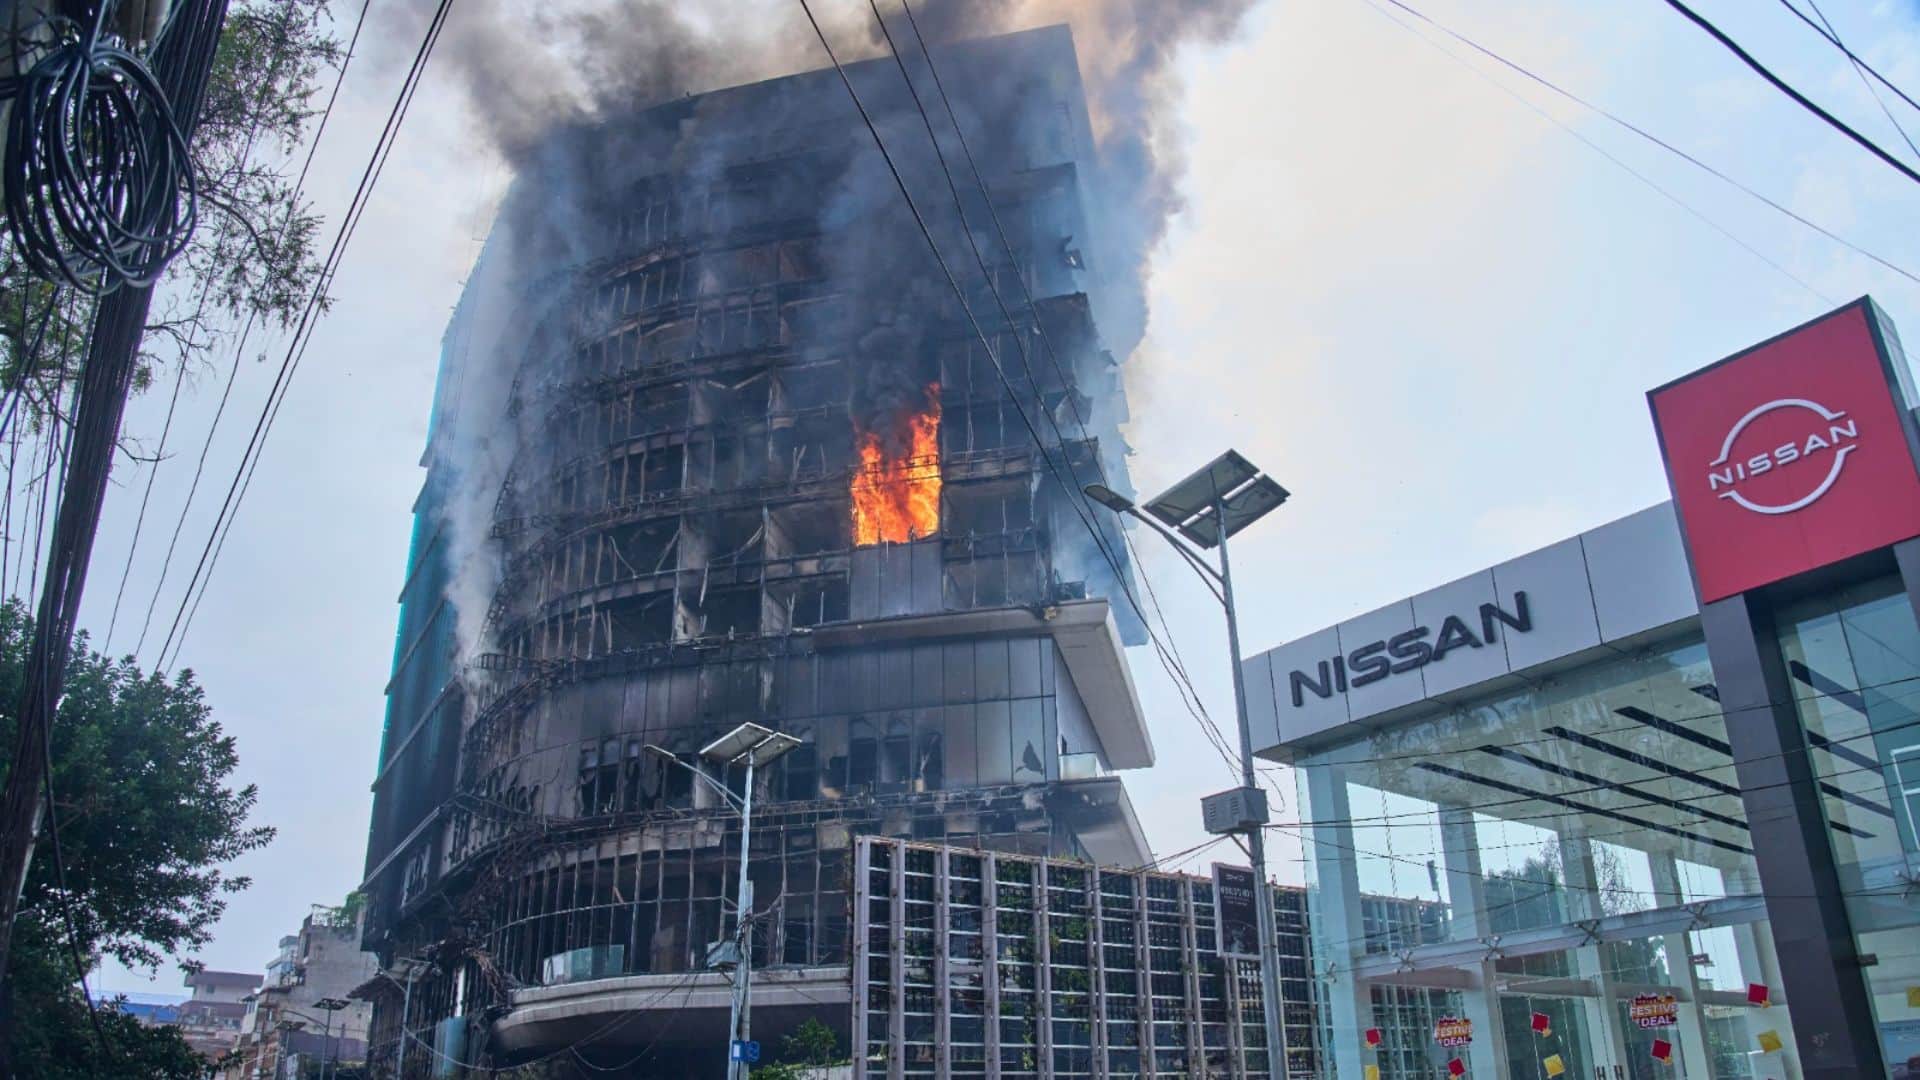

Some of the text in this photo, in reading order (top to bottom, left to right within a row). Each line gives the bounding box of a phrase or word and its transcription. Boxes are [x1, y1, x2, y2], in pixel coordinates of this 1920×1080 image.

[1708, 419, 1858, 490] NISSAN
[1290, 590, 1532, 707] NISSAN
[1631, 1003, 1679, 1017] FESTIVE
[1641, 1015, 1673, 1027] DEAL
[1443, 1036, 1469, 1047] DEAL
